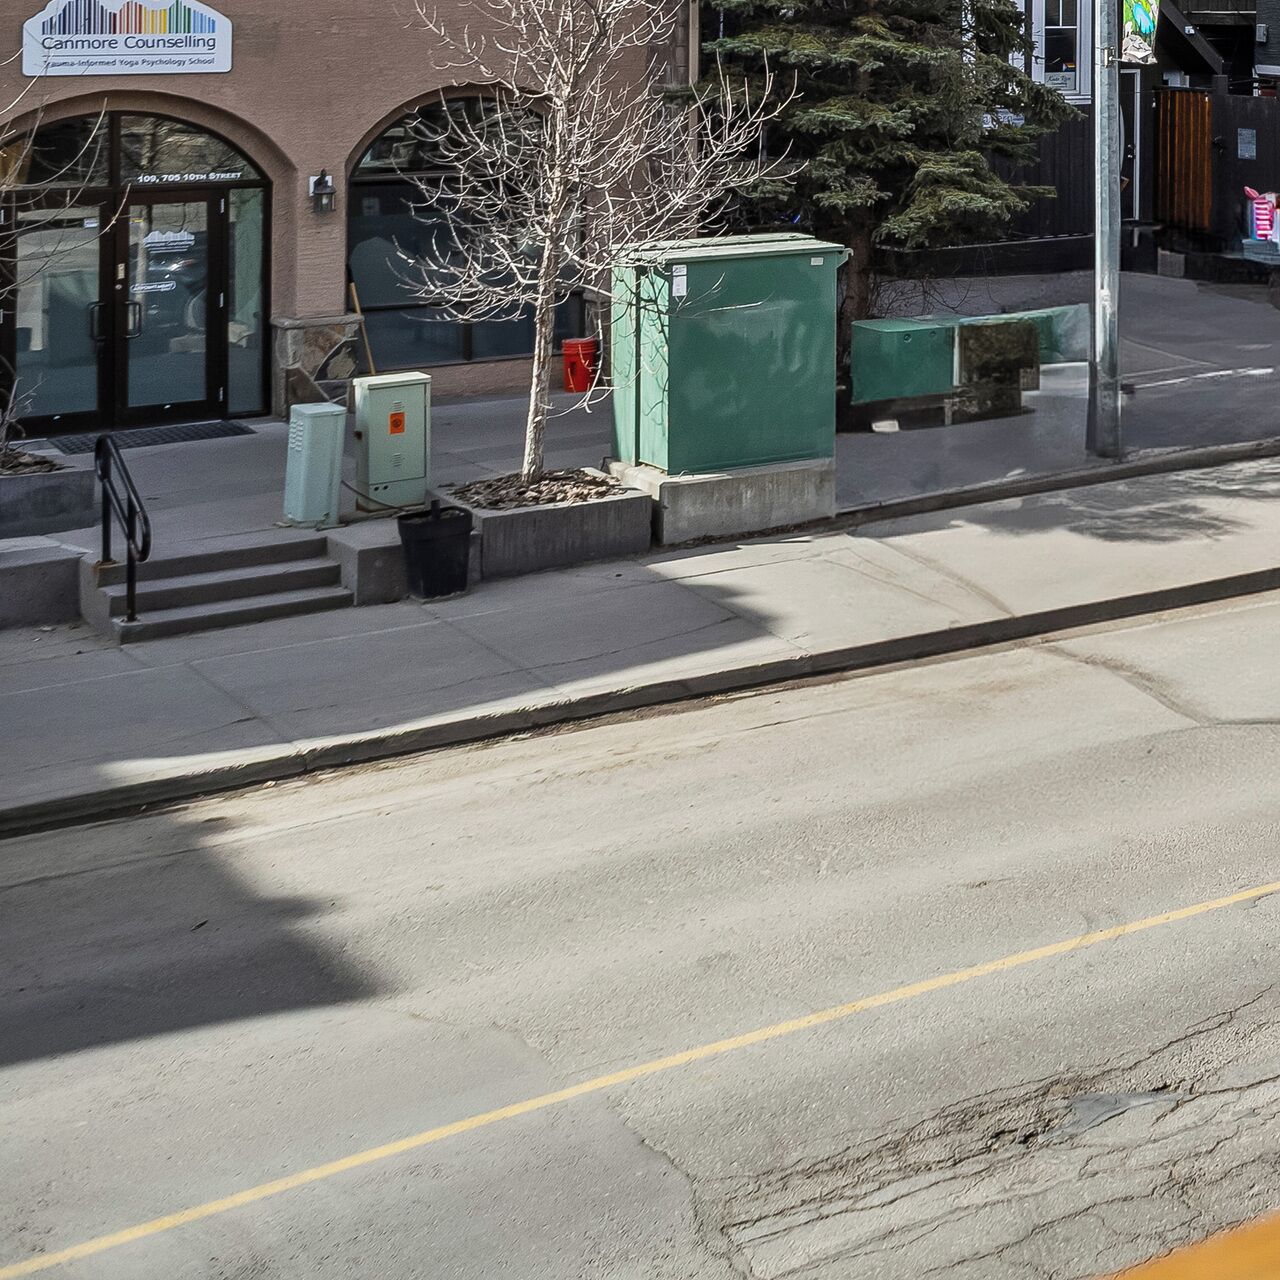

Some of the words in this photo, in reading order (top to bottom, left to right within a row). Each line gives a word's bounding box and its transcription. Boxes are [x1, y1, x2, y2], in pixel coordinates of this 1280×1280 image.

[42, 36, 118, 50] Canmore
[124, 35, 216, 51] Counselling
[119, 59, 139, 67] Yoga
[141, 58, 187, 67] Psychology
[188, 57, 215, 65] School
[162, 173, 181, 182] 705
